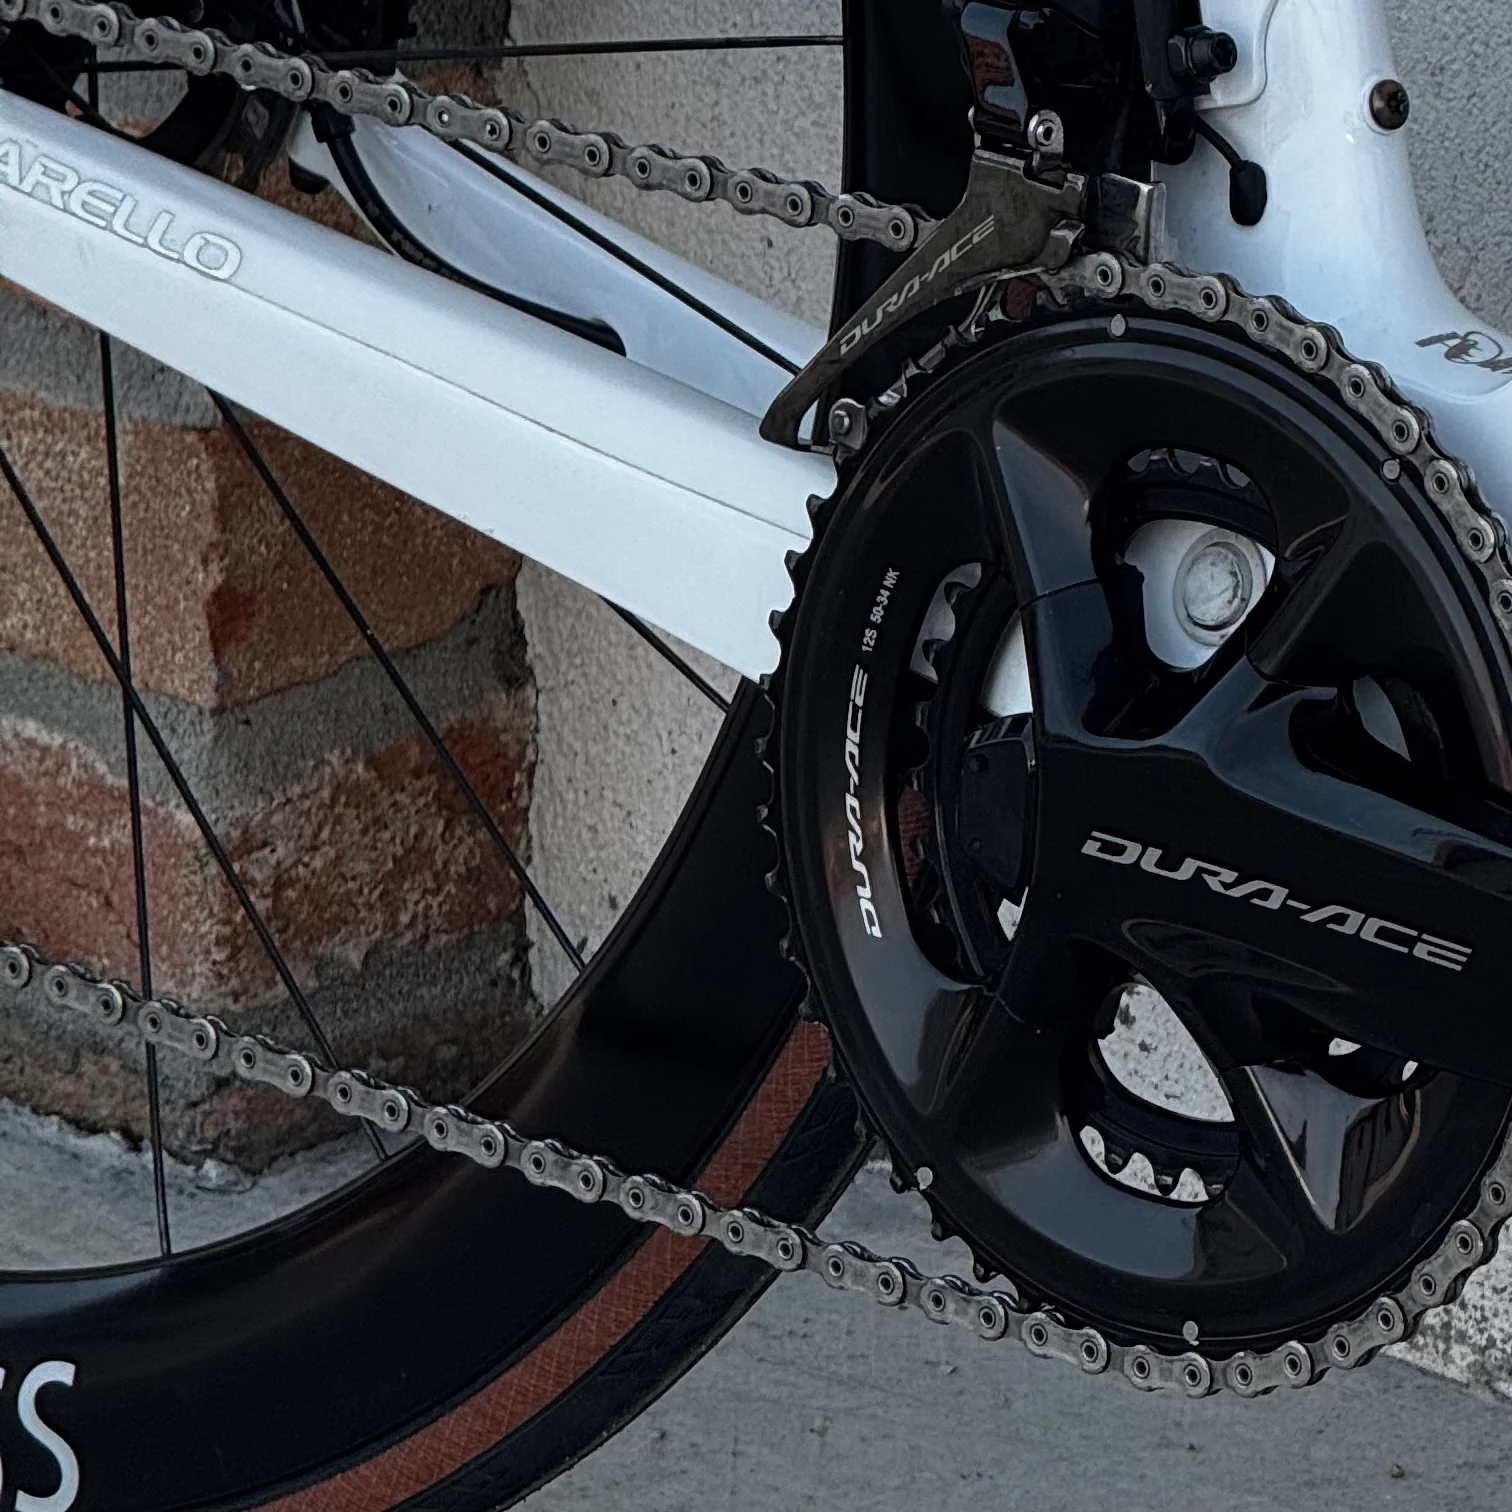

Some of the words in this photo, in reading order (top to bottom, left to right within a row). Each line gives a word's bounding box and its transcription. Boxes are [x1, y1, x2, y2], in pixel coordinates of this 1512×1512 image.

[839, 215, 995, 356] DURA-ACE
[861, 628, 877, 651] 12S
[870, 589, 891, 623] 50-34
[882, 568, 900, 588] NK
[844, 662, 883, 939] DURA-ACE
[1080, 829, 1473, 972] DURA-ACE
[0, 1359, 80, 1512] S
